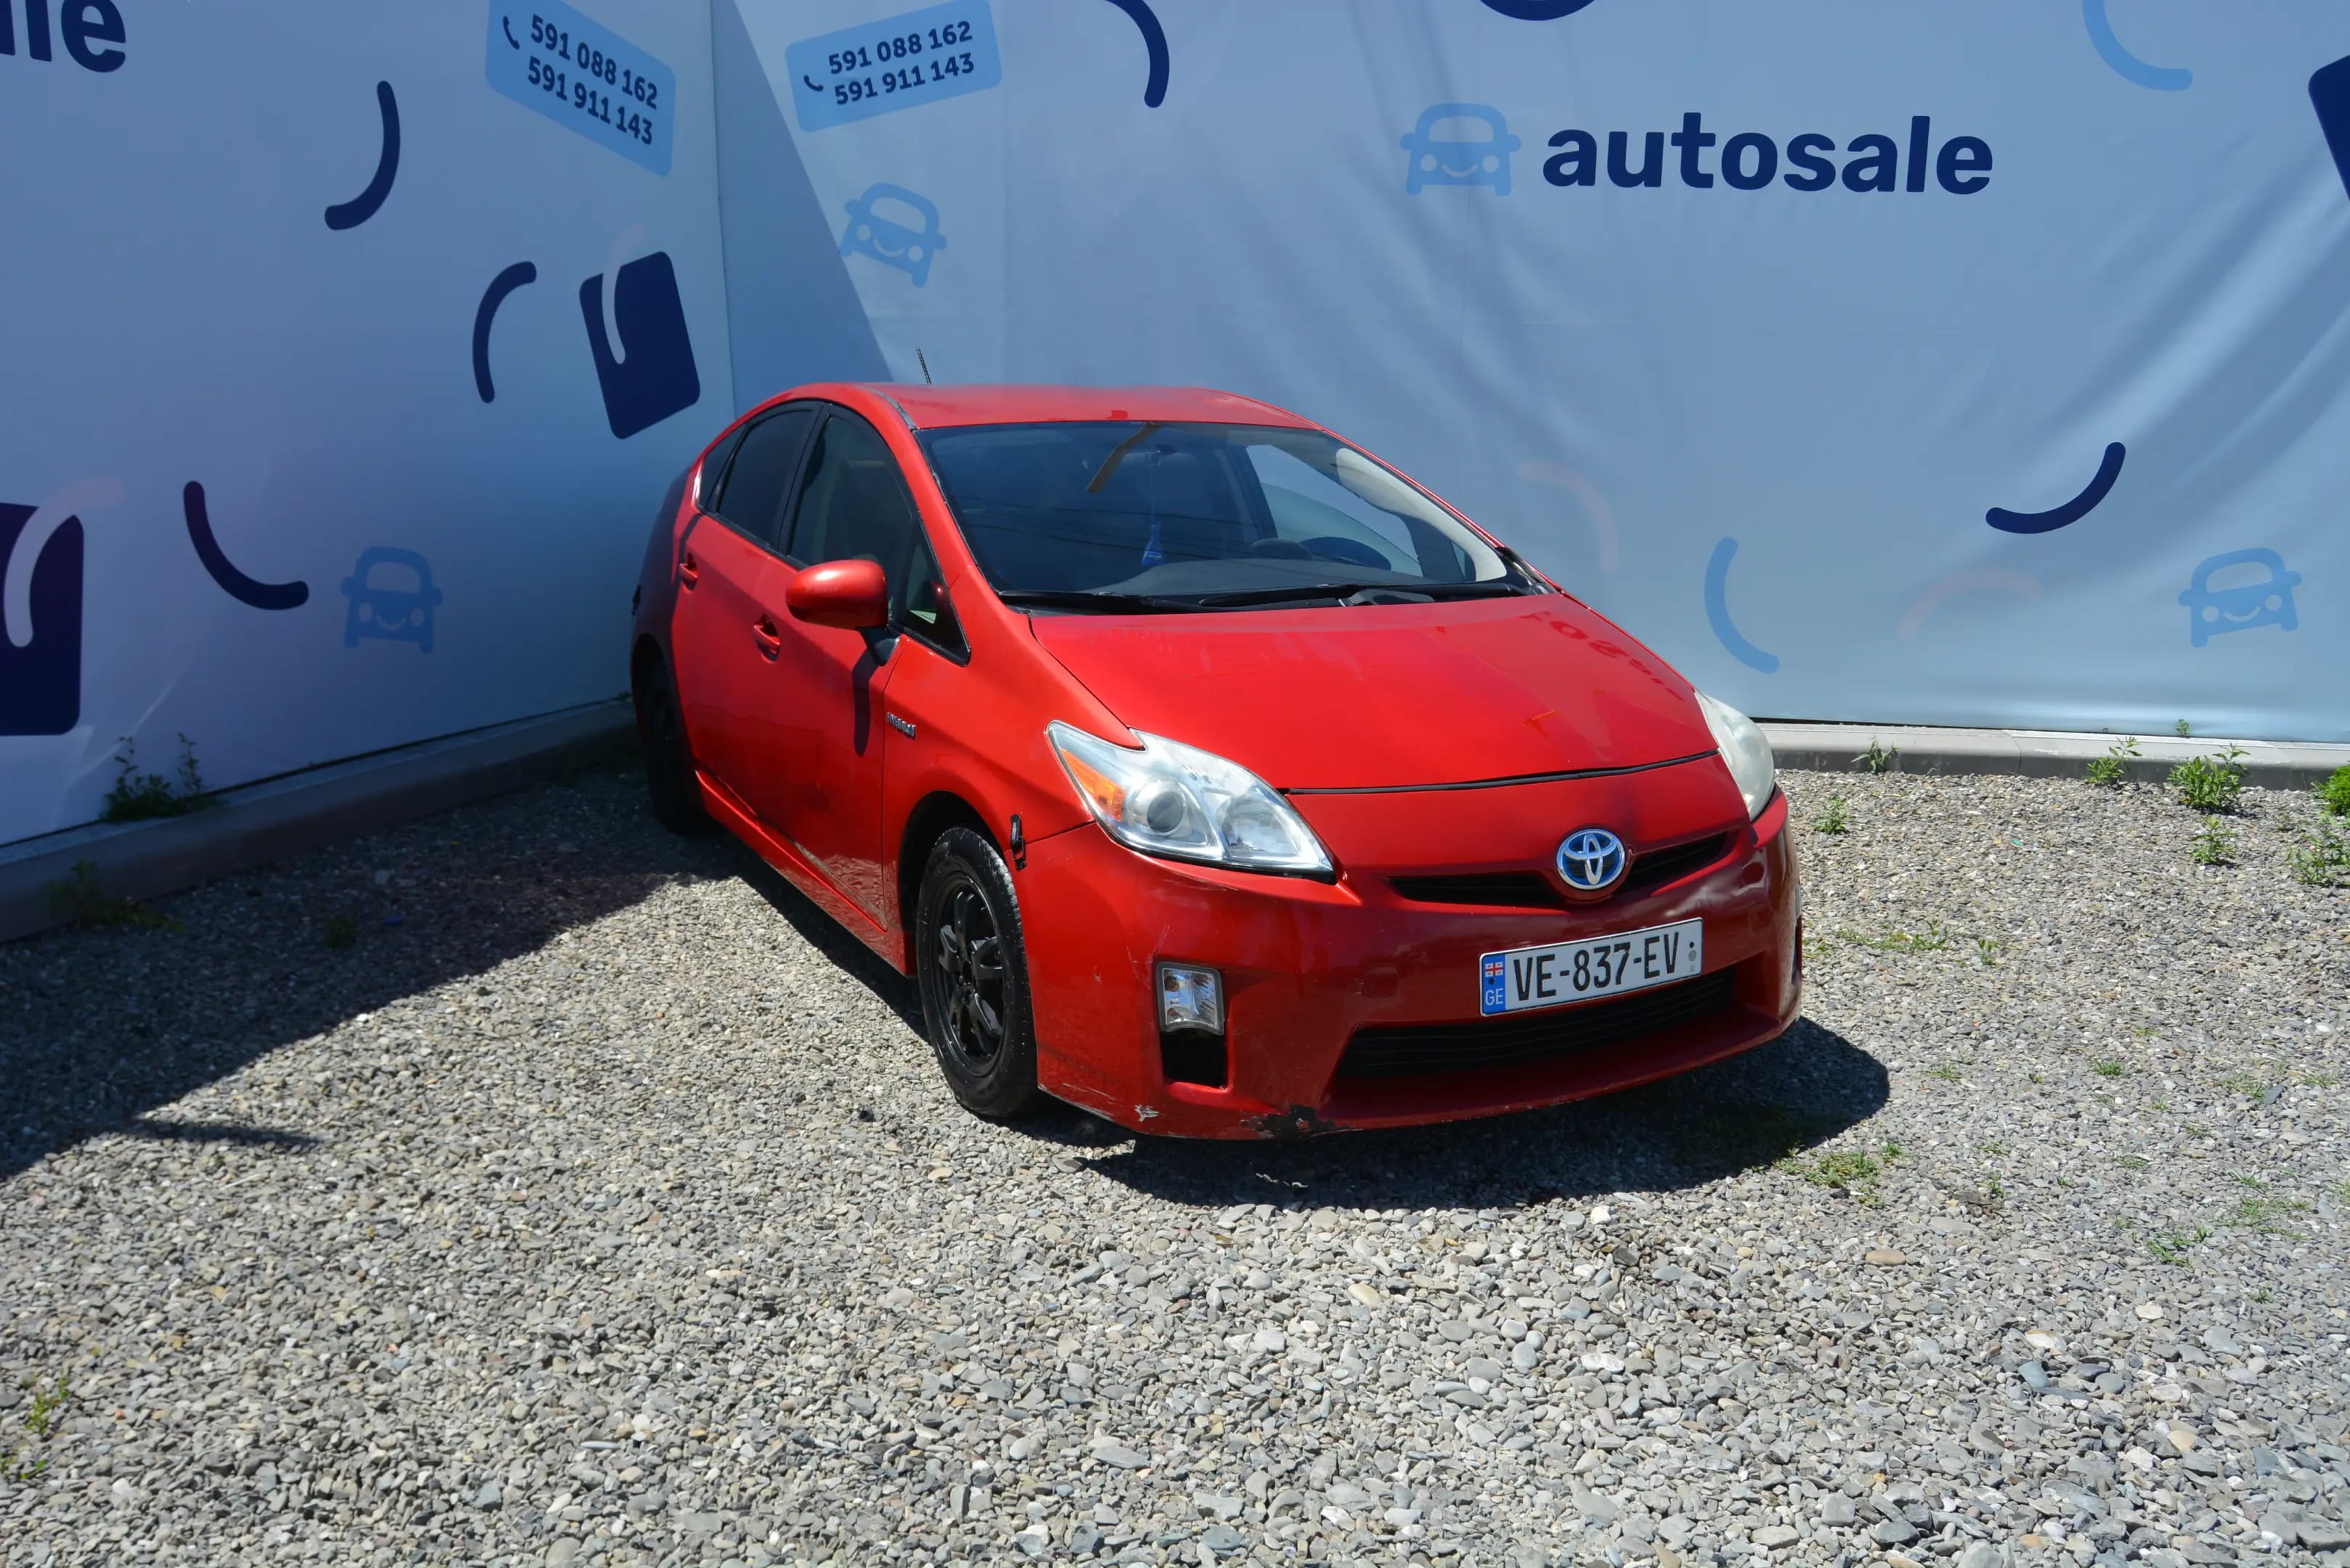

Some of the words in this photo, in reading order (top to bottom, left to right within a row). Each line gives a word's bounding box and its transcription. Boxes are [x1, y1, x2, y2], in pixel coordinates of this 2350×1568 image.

[529, 12, 572, 62] 591
[576, 41, 617, 86] 088
[621, 68, 659, 112] 162
[828, 46, 873, 75] 591
[876, 32, 923, 63] 088
[927, 20, 974, 51] 162
[833, 76, 879, 106] 591
[881, 65, 926, 94] 911
[929, 51, 975, 83] 143
[526, 54, 568, 103] 591
[573, 81, 612, 126] 911
[615, 105, 653, 147] 143
[1542, 111, 1994, 195] autosale
[1485, 988, 1504, 1005] GE
[1513, 931, 1679, 1001] VE-837-EV
